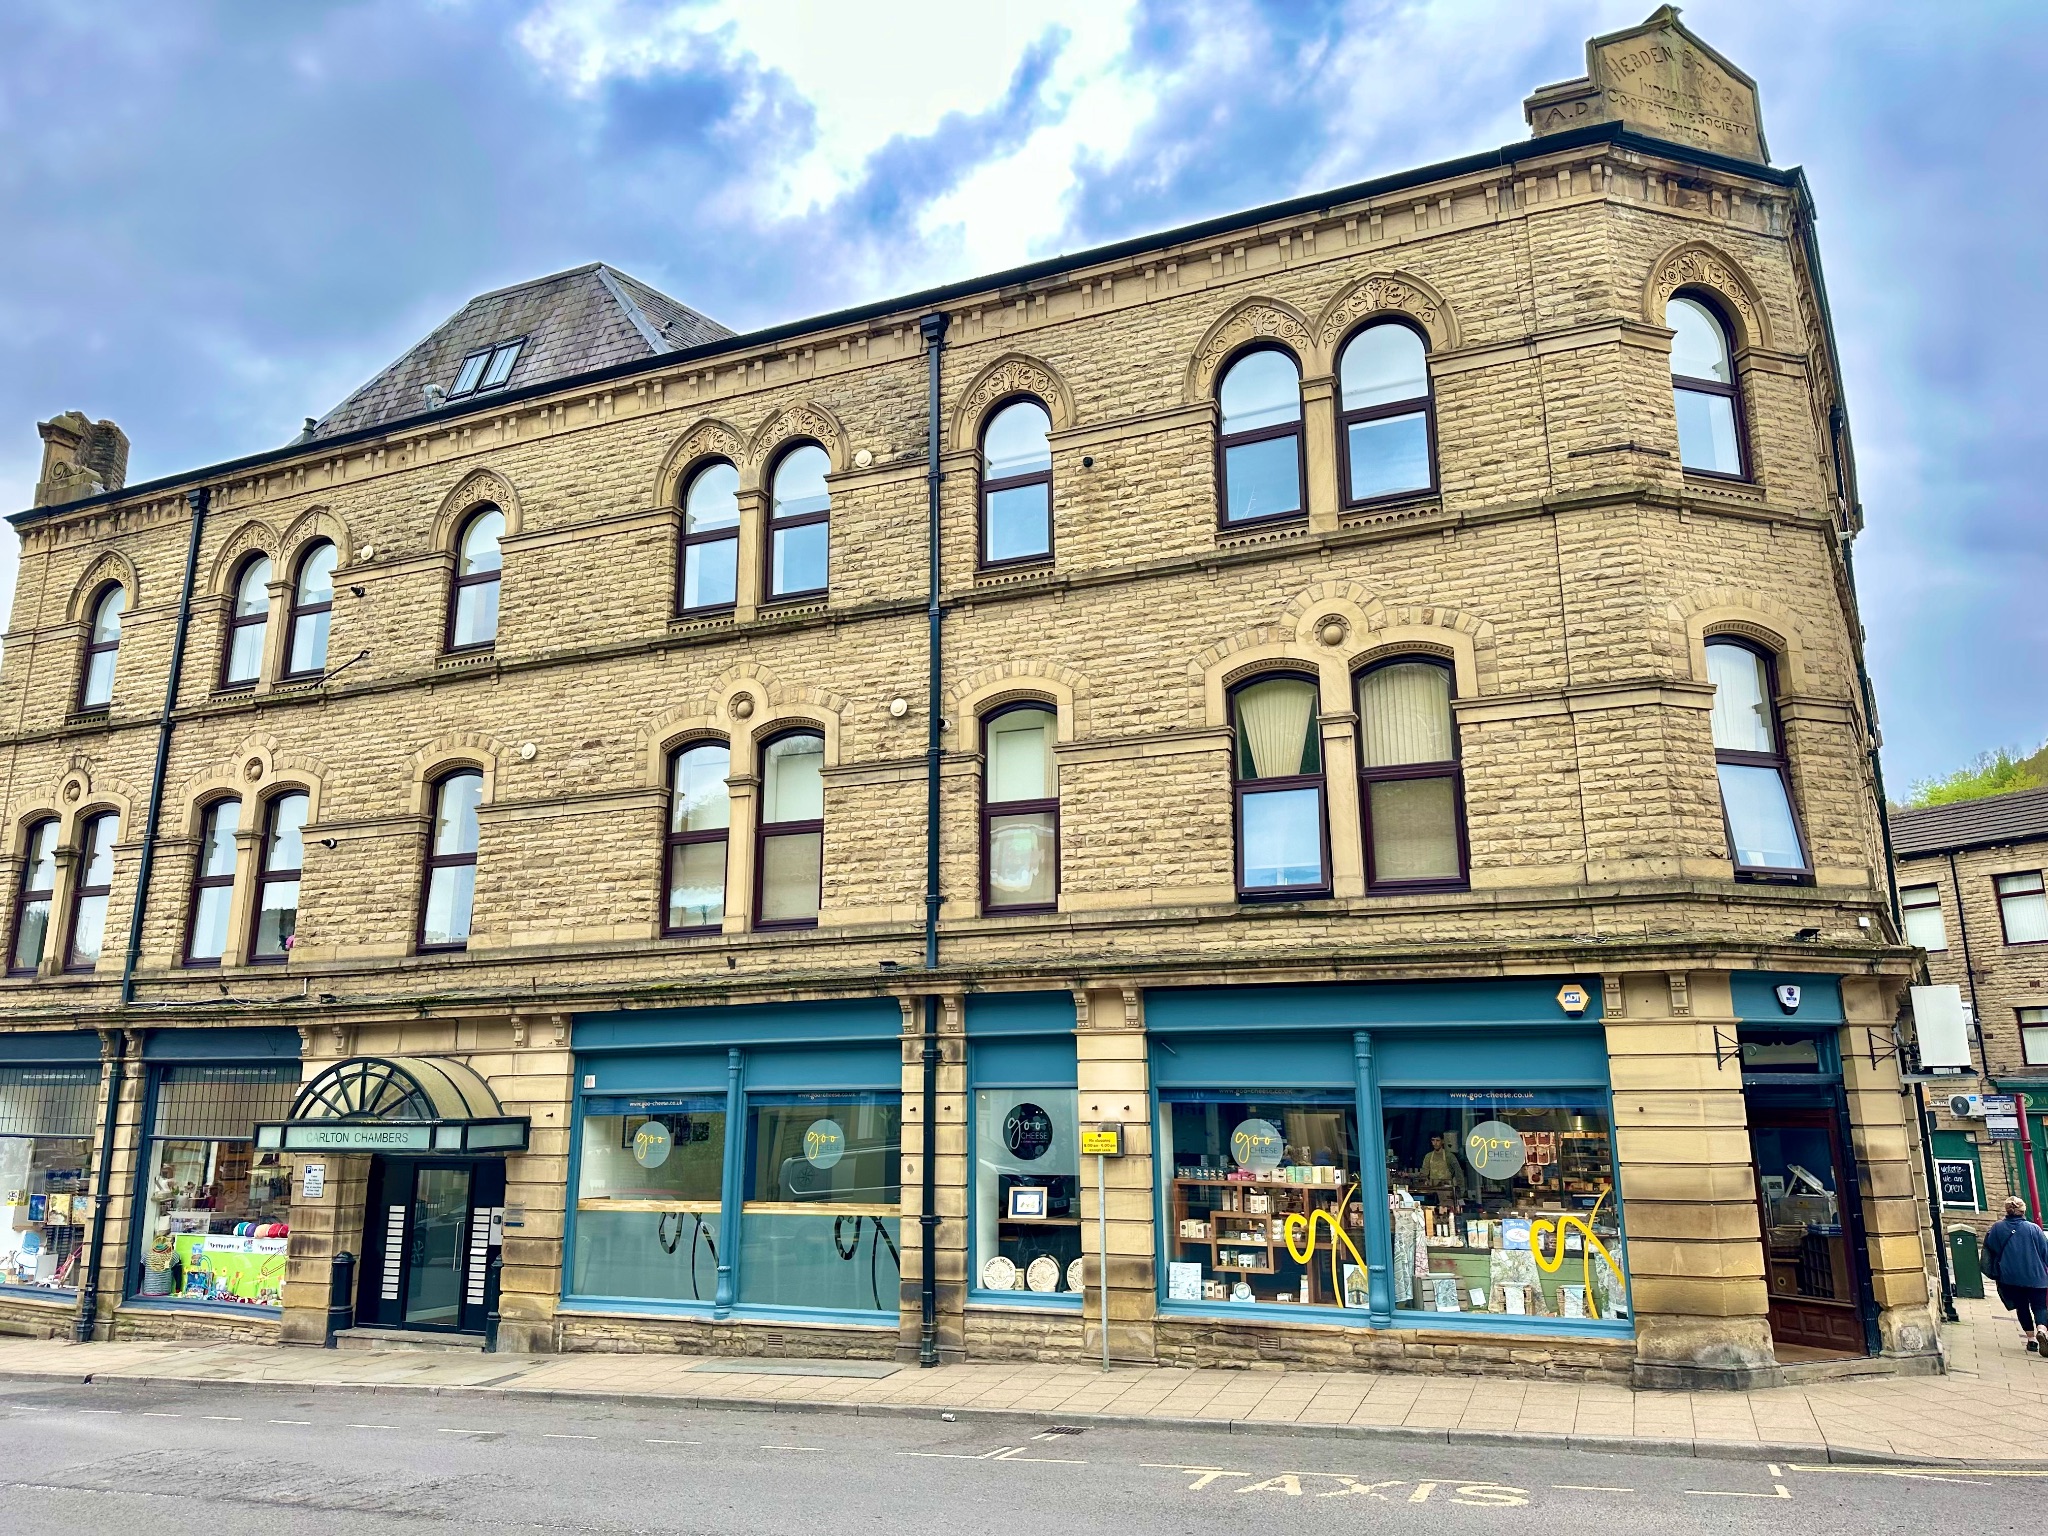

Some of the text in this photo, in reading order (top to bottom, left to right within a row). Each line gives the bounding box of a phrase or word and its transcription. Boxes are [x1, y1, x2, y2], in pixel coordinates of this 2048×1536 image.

[1606, 46, 1674, 83] HEBDEN
[1698, 113, 1749, 136] SOCIETY
[1565, 994, 1581, 1002] ADT
[1450, 1091, 1534, 1100] www.goo-cheese.co.uk
[306, 1132, 409, 1143] CARLTON CHAMBERS
[1008, 1117, 1047, 1149] goo
[1020, 1131, 1048, 1140] CHEESE
[637, 1132, 668, 1159] goo
[808, 1131, 840, 1159] goo
[1235, 1132, 1277, 1164] goo
[1249, 1146, 1279, 1154] CHEESE
[1471, 1135, 1518, 1168] goo
[1487, 1150, 1520, 1159] CHEESE
[1957, 1237, 1963, 1245] 2
[1182, 1469, 1530, 1507] TAXIS
